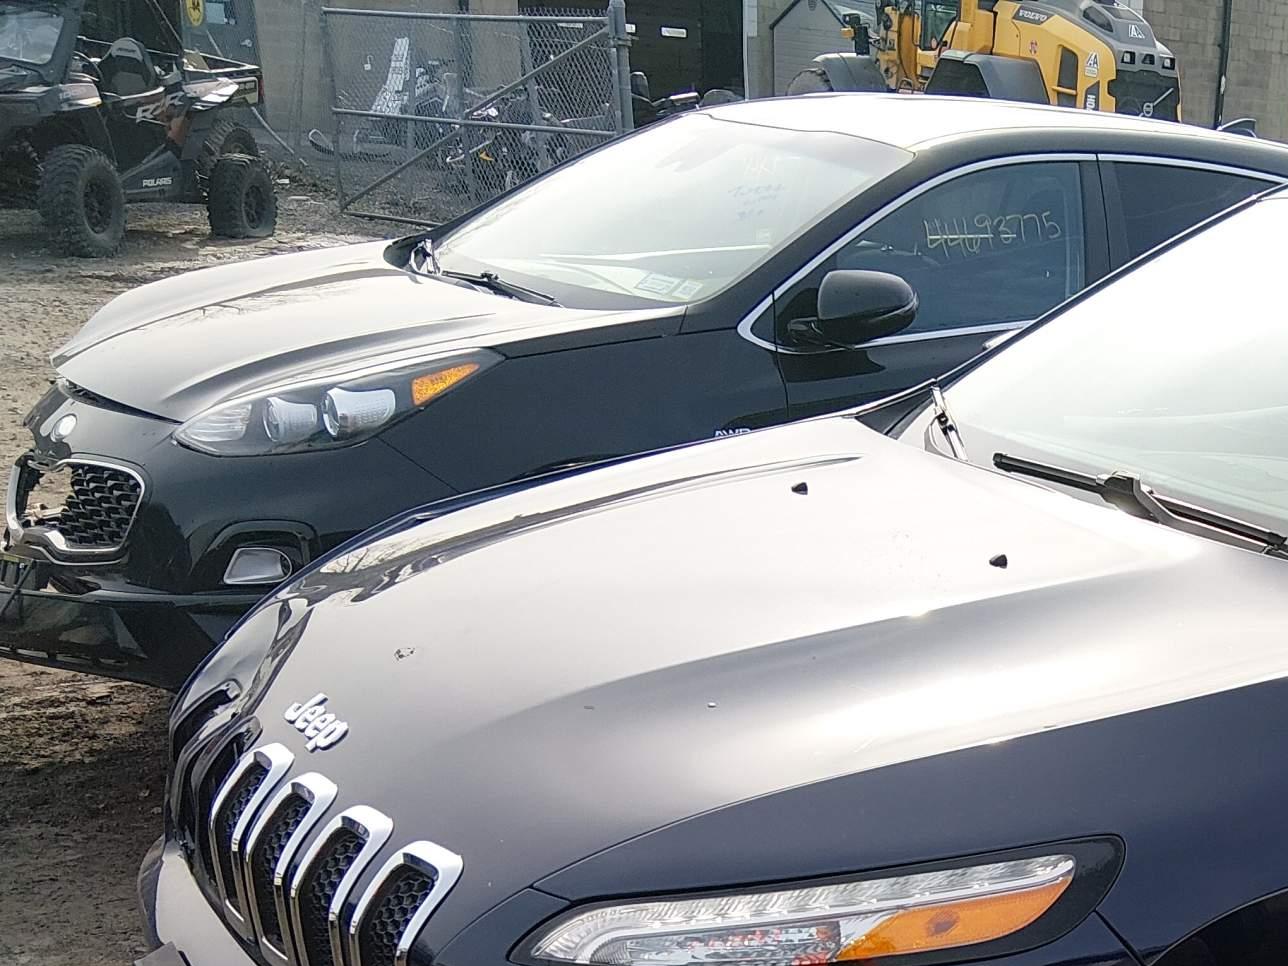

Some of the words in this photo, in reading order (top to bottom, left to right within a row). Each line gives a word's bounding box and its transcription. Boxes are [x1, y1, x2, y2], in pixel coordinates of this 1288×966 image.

[1019, 9, 1047, 22] VOLVO
[142, 177, 173, 187] POLARIS
[284, 692, 349, 753] Jeep
